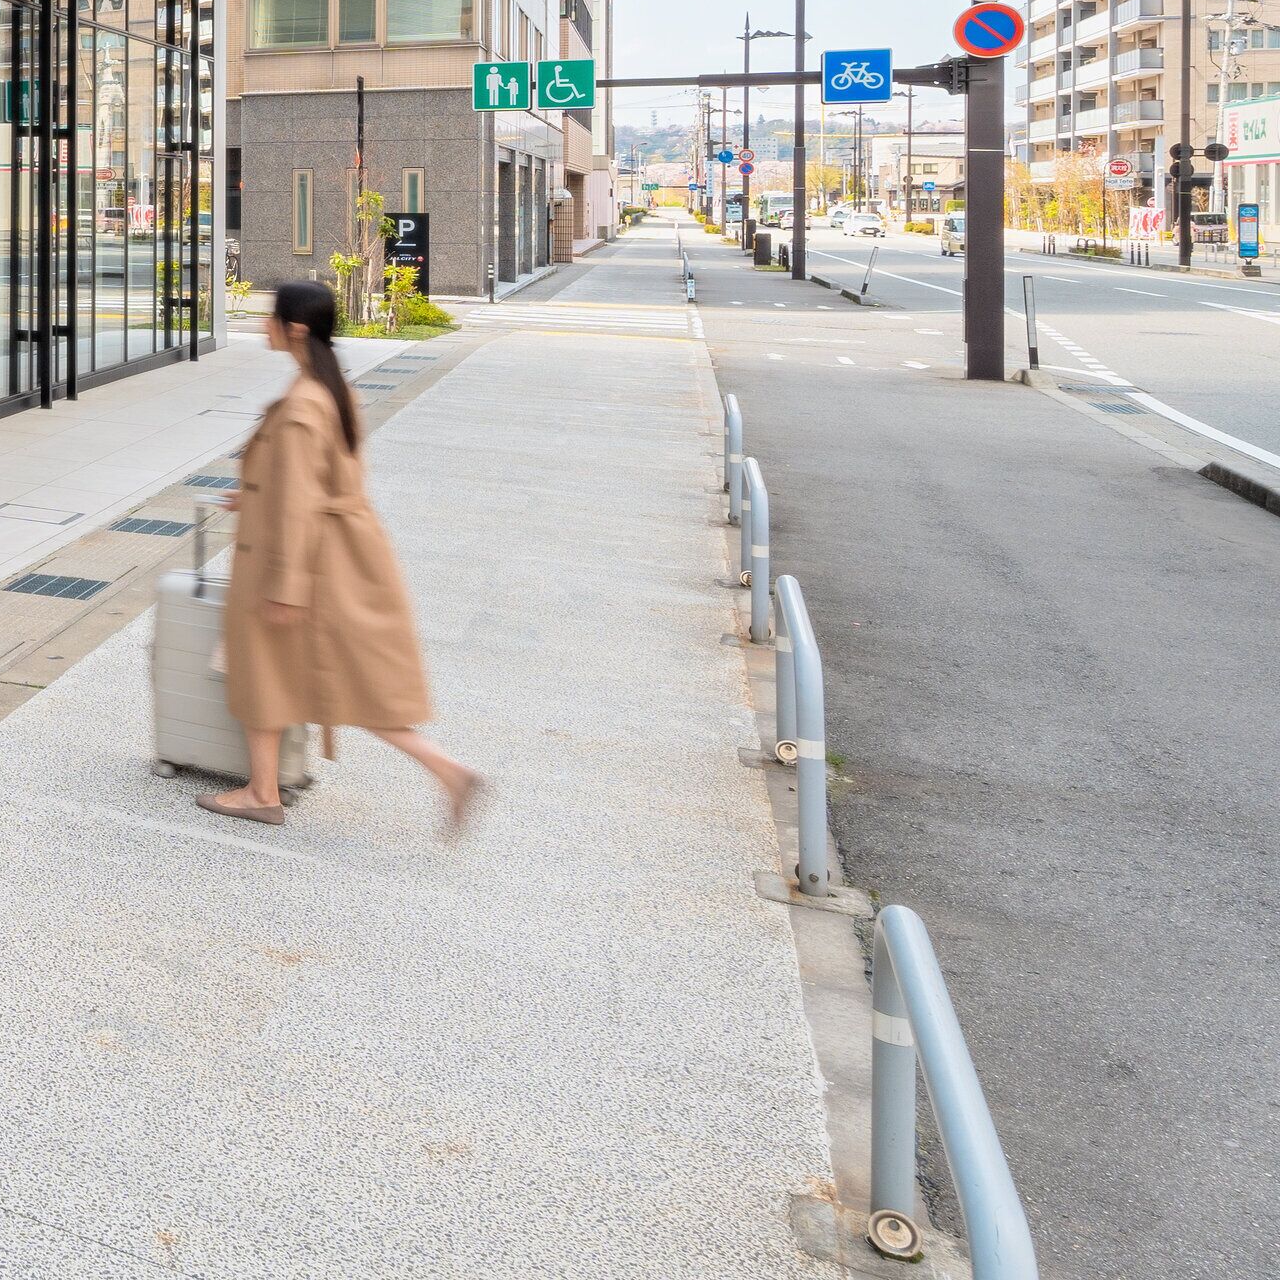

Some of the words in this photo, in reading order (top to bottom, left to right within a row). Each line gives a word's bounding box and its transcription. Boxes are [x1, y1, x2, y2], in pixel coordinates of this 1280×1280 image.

[1242, 117, 1267, 141] セイムス
[398, 219, 416, 237] P
